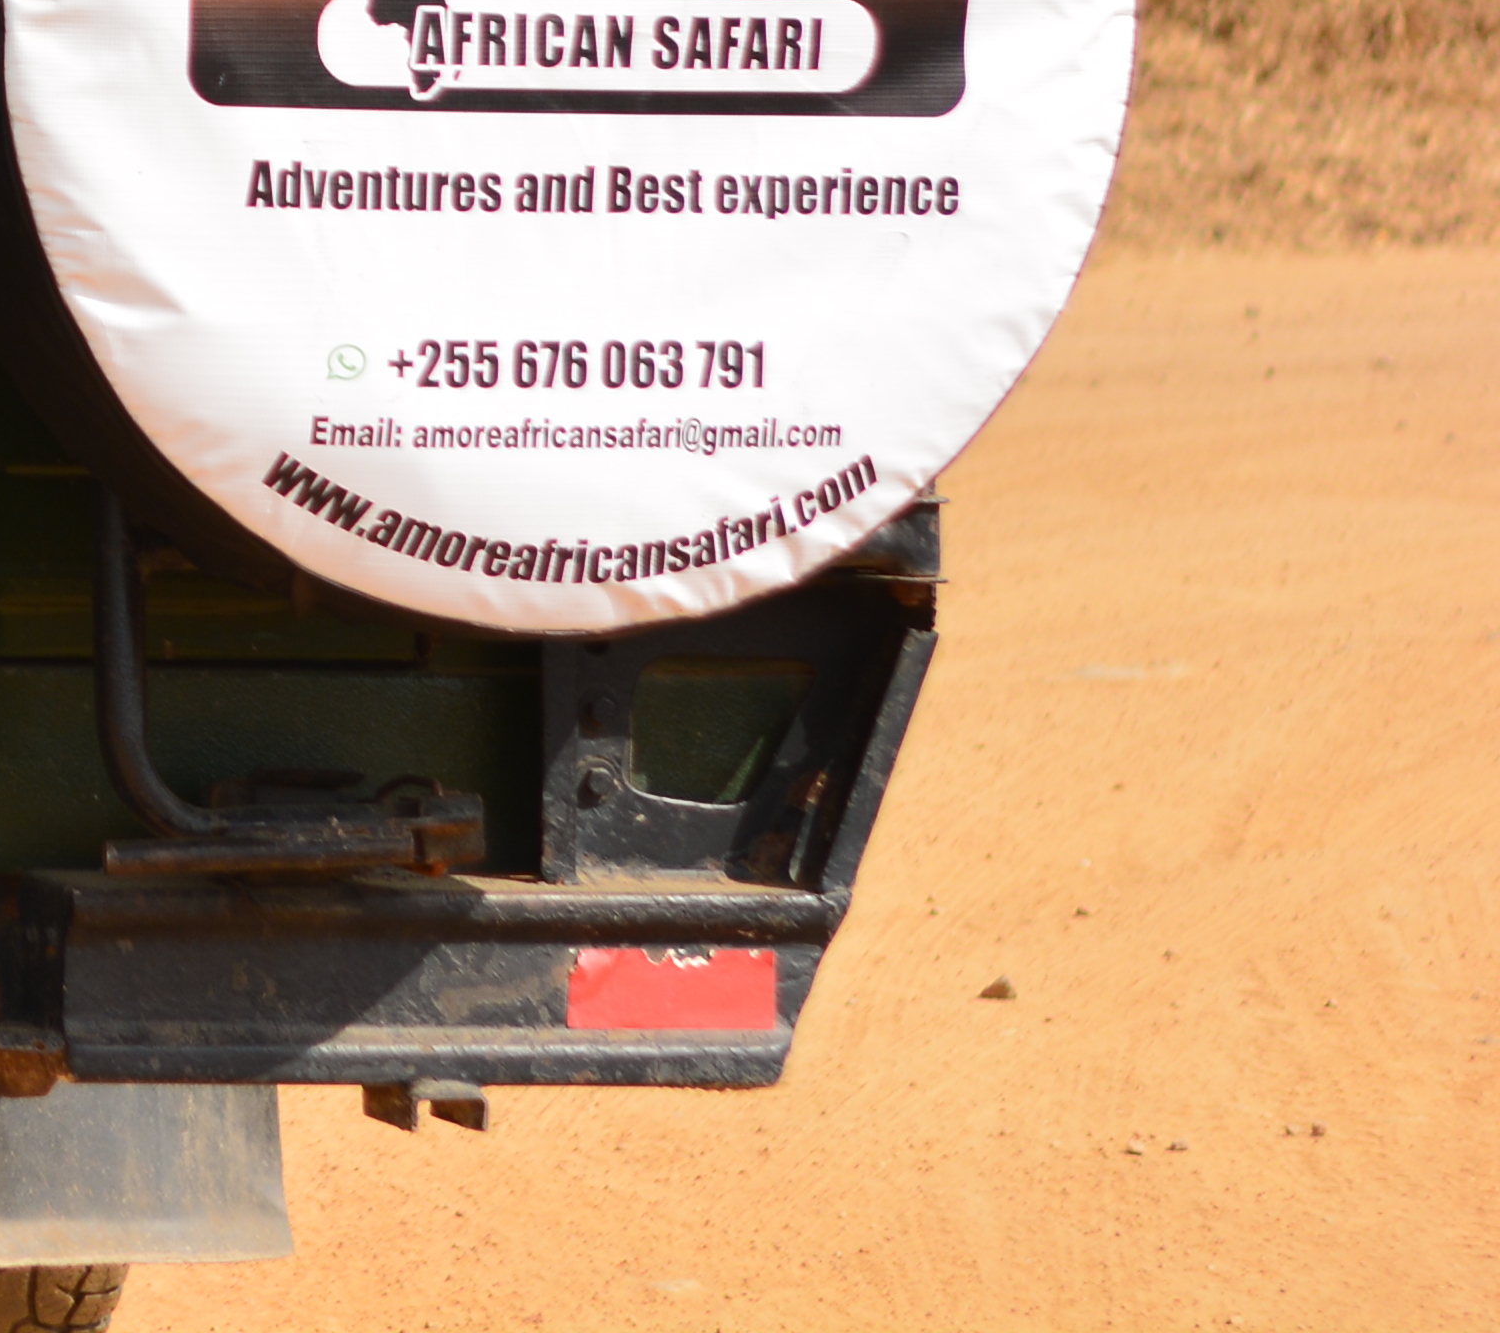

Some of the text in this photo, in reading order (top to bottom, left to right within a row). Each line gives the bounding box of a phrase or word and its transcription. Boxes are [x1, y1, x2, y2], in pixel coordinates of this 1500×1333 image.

[412, 10, 824, 72] AFRICAN SAFARI
[246, 159, 960, 221] Adventures and Best experience
[389, 339, 765, 390] +255 676 063 791
[310, 416, 843, 457] Email: amoreafricansafari@gmail.com
[262, 450, 878, 585] www.amoreafricansafari.com
